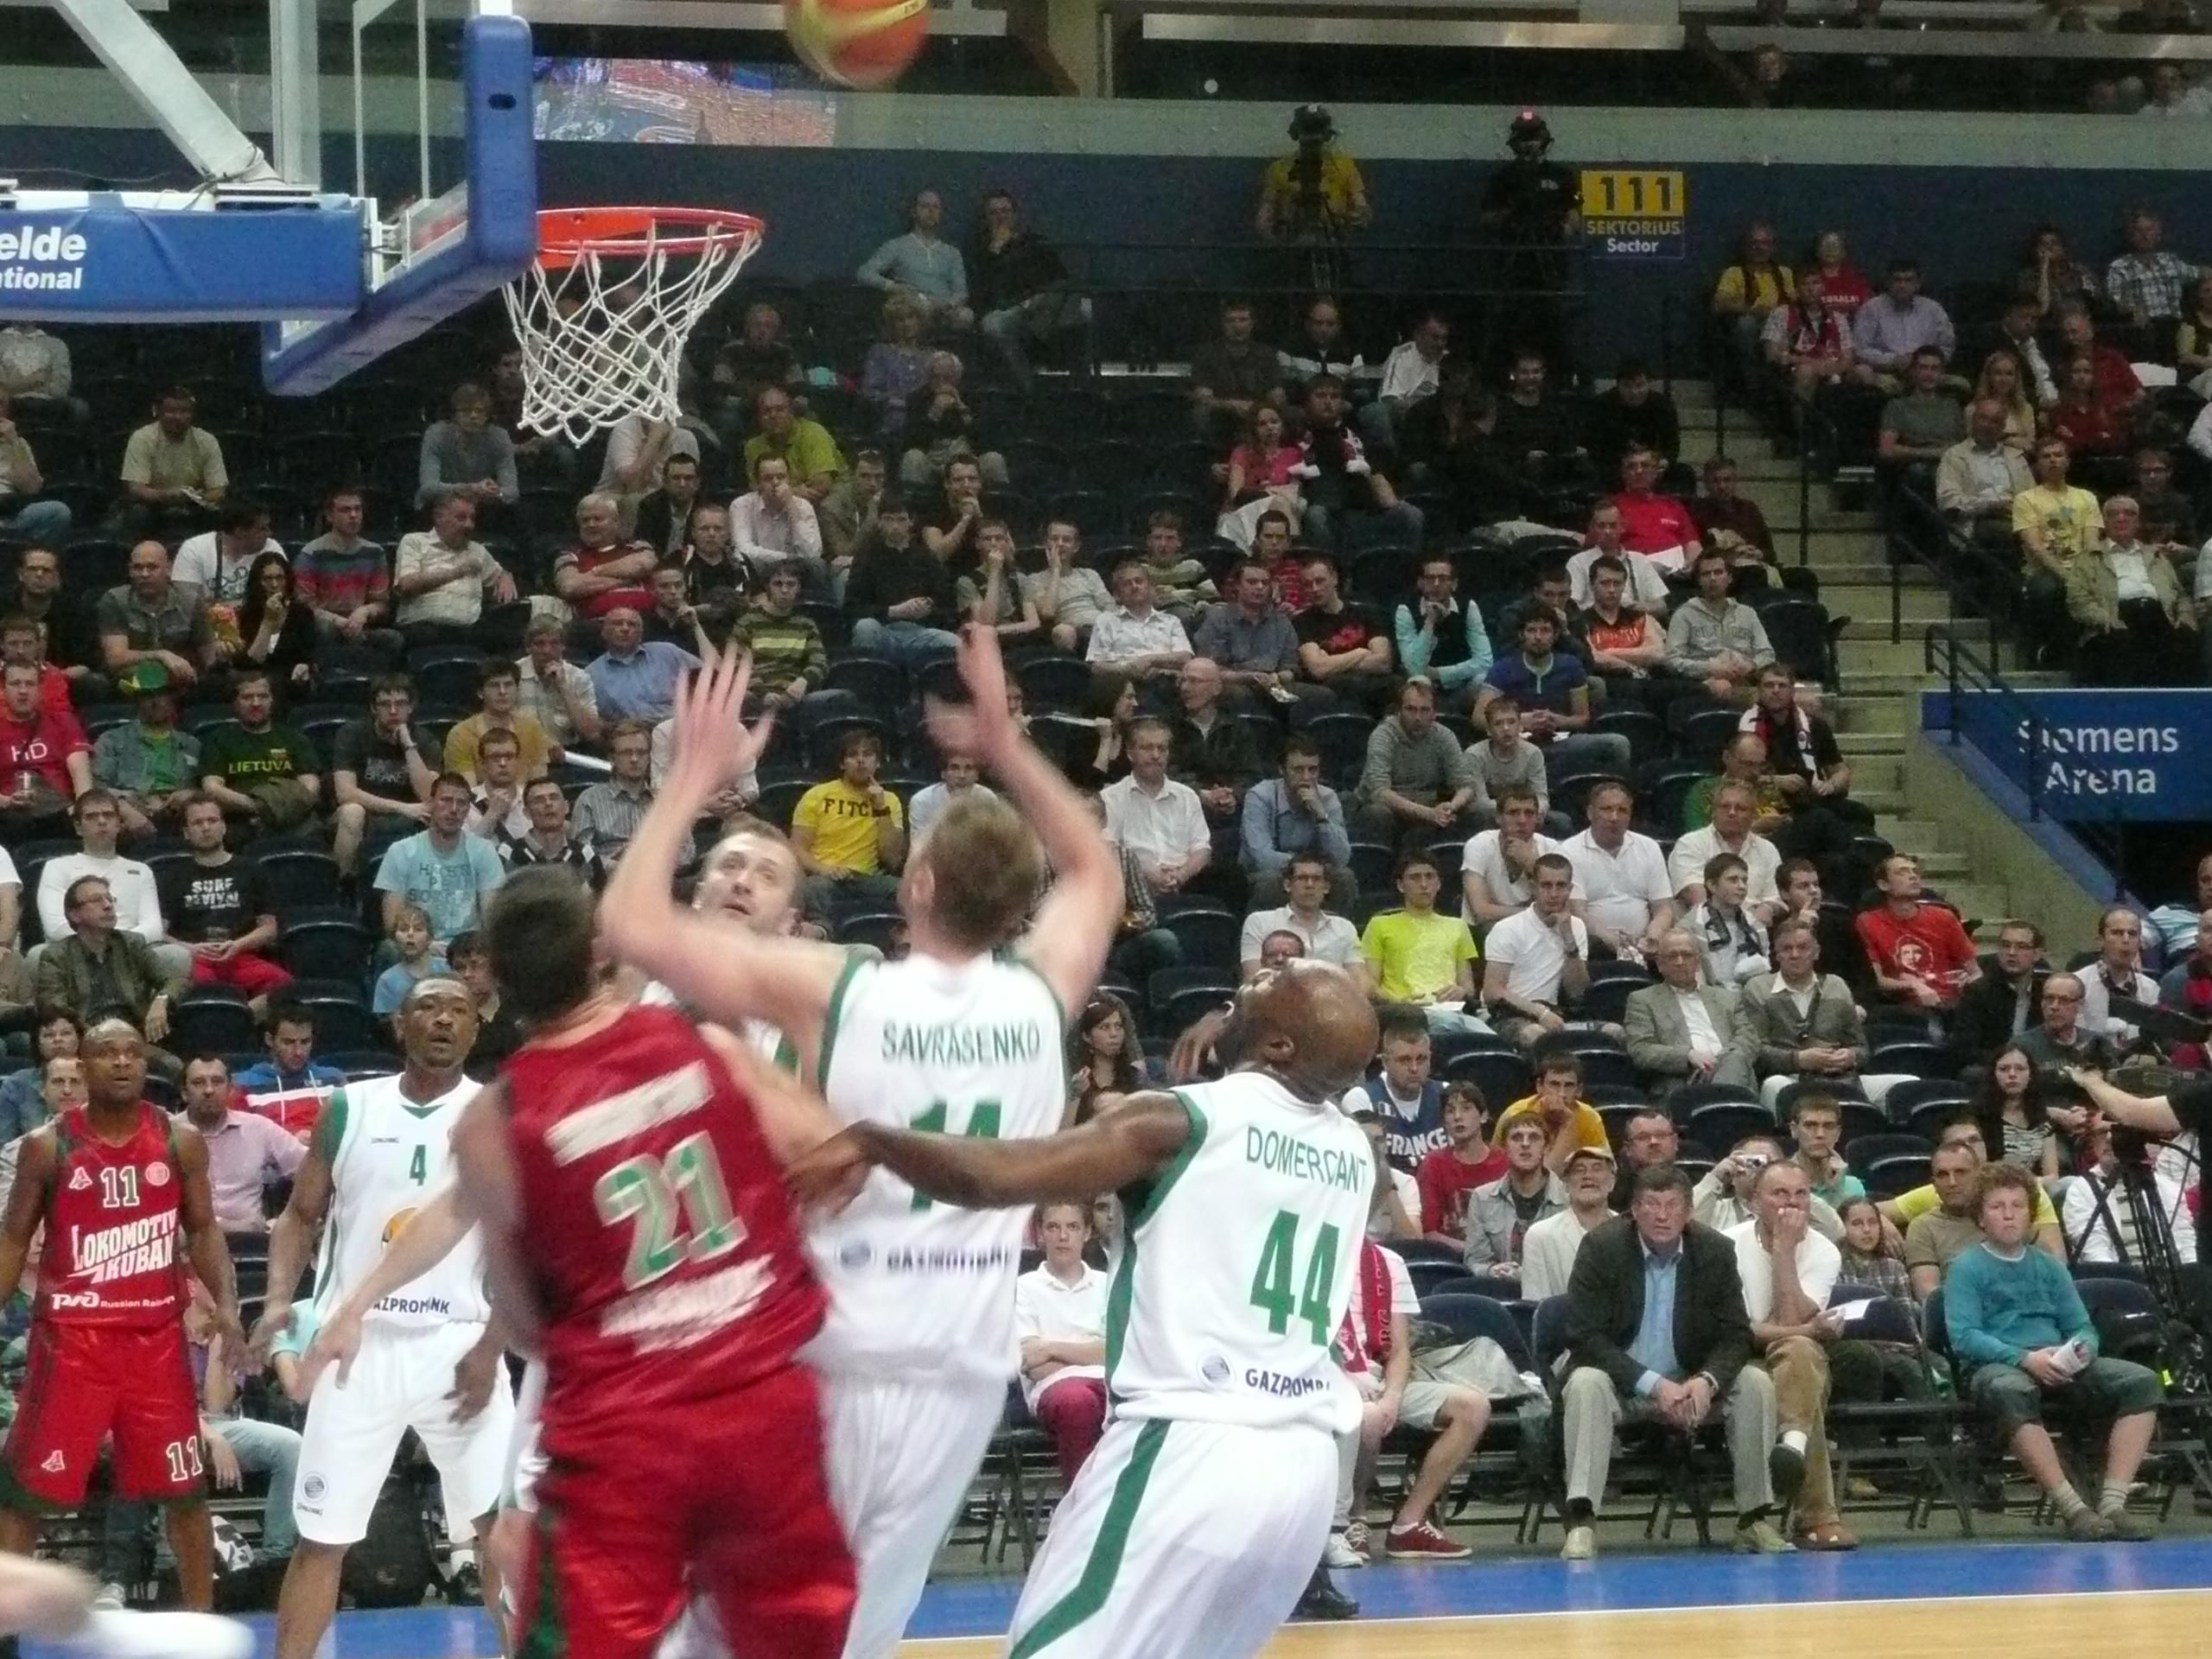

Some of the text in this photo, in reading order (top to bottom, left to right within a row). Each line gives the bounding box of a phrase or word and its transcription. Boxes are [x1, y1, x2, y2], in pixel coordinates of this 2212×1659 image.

[1599, 176, 1670, 212] 111
[1586, 221, 1681, 236] SEKTORIUS
[1606, 238, 1660, 252] Sector
[0, 266, 83, 289] tional
[228, 761, 292, 774] LIETUVA
[2044, 760, 2157, 794] Arena
[823, 798, 874, 818] FITC
[881, 1018, 1040, 1065] SAVRASENKO
[1246, 1126, 1368, 1193] DOMERCANT
[1384, 1127, 1448, 1156] FRANCE
[409, 1144, 427, 1186] 4
[100, 1166, 140, 1208] 11
[593, 1128, 750, 1292] 21
[71, 1207, 178, 1272] LOKOMOTIV
[103, 1230, 175, 1282] KUBAN
[1249, 1210, 1340, 1347] 44
[166, 1435, 203, 1482] 11
